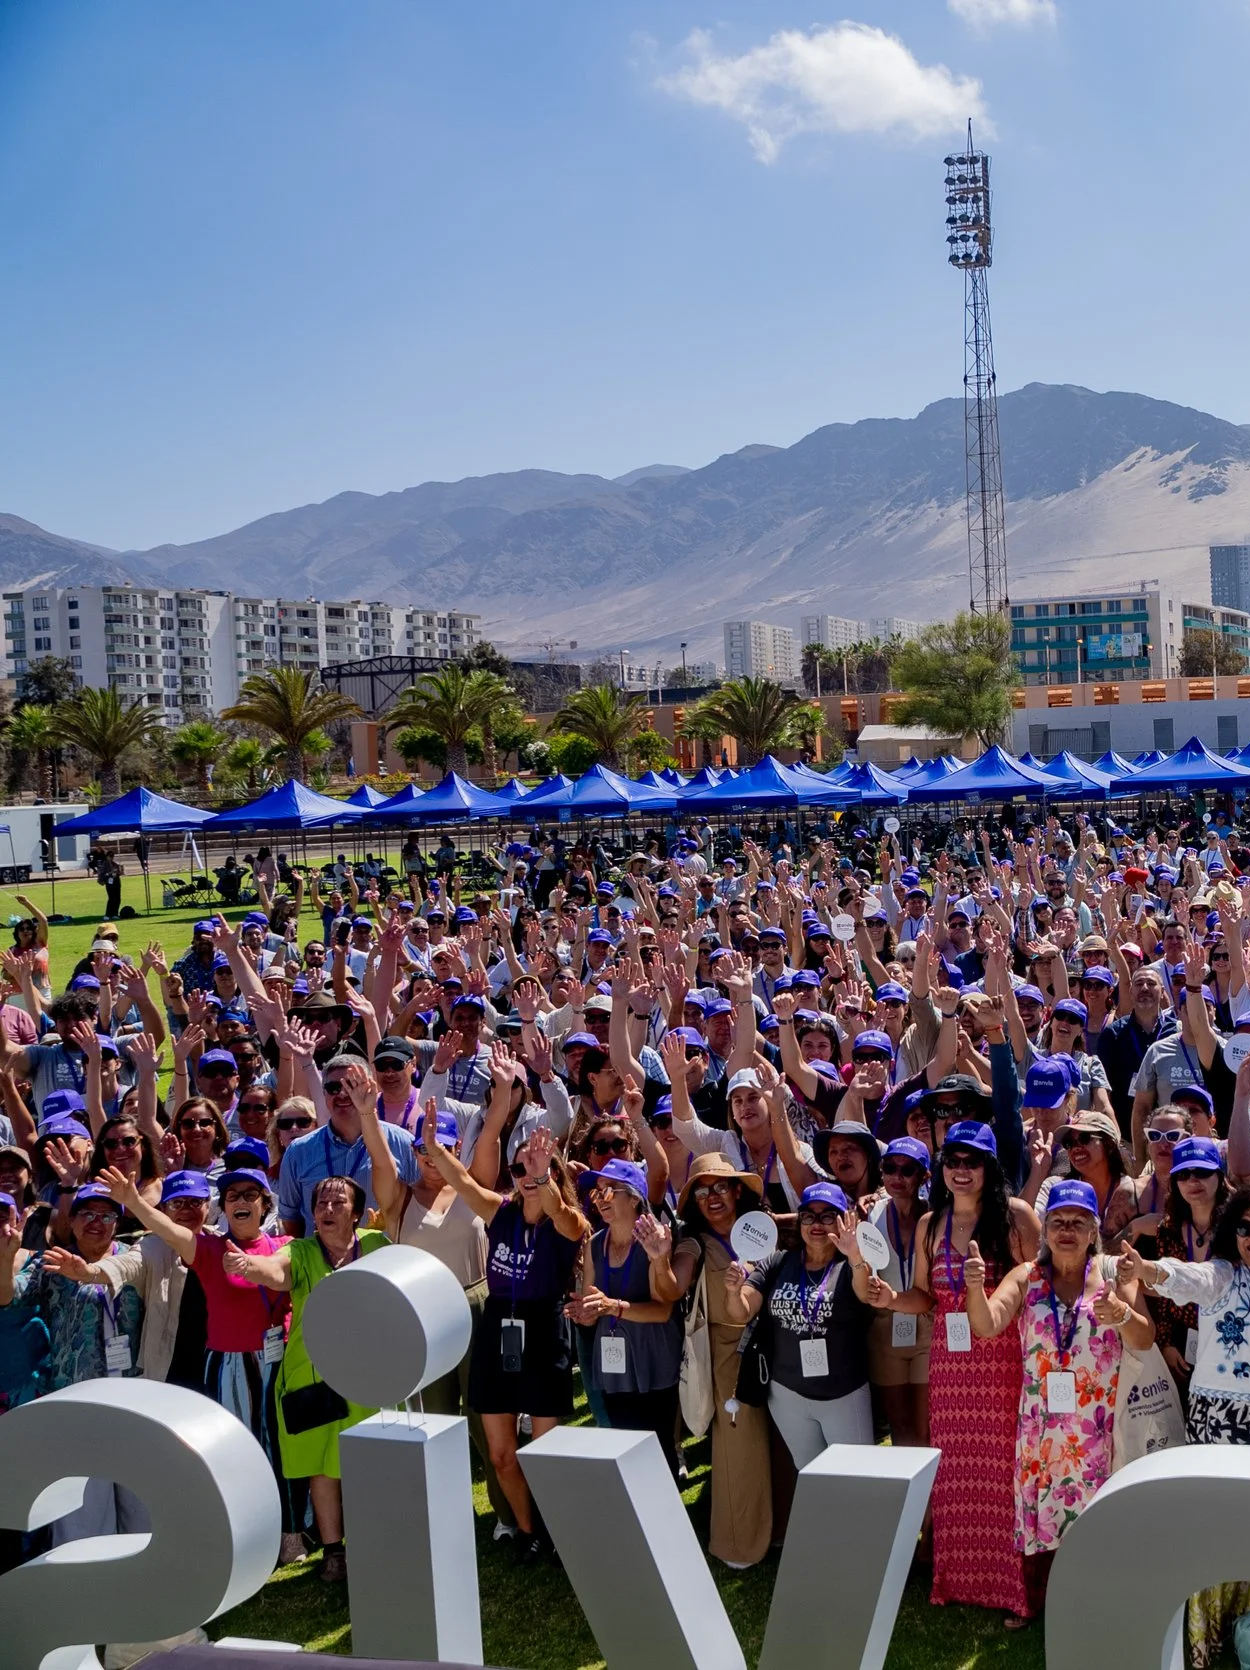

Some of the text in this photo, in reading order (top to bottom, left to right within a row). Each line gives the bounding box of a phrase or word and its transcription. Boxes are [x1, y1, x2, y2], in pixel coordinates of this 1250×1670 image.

[1066, 1188, 1083, 1197] envis
[750, 1227, 768, 1241] envis
[782, 1282, 799, 1291] I'M
[772, 1288, 833, 1303] BOSSY
[773, 1300, 798, 1309] JUST
[778, 1314, 824, 1324] THINGS
[816, 1310, 832, 1318] DO
[790, 1320, 810, 1335] Right
[1142, 1376, 1170, 1399] envis
